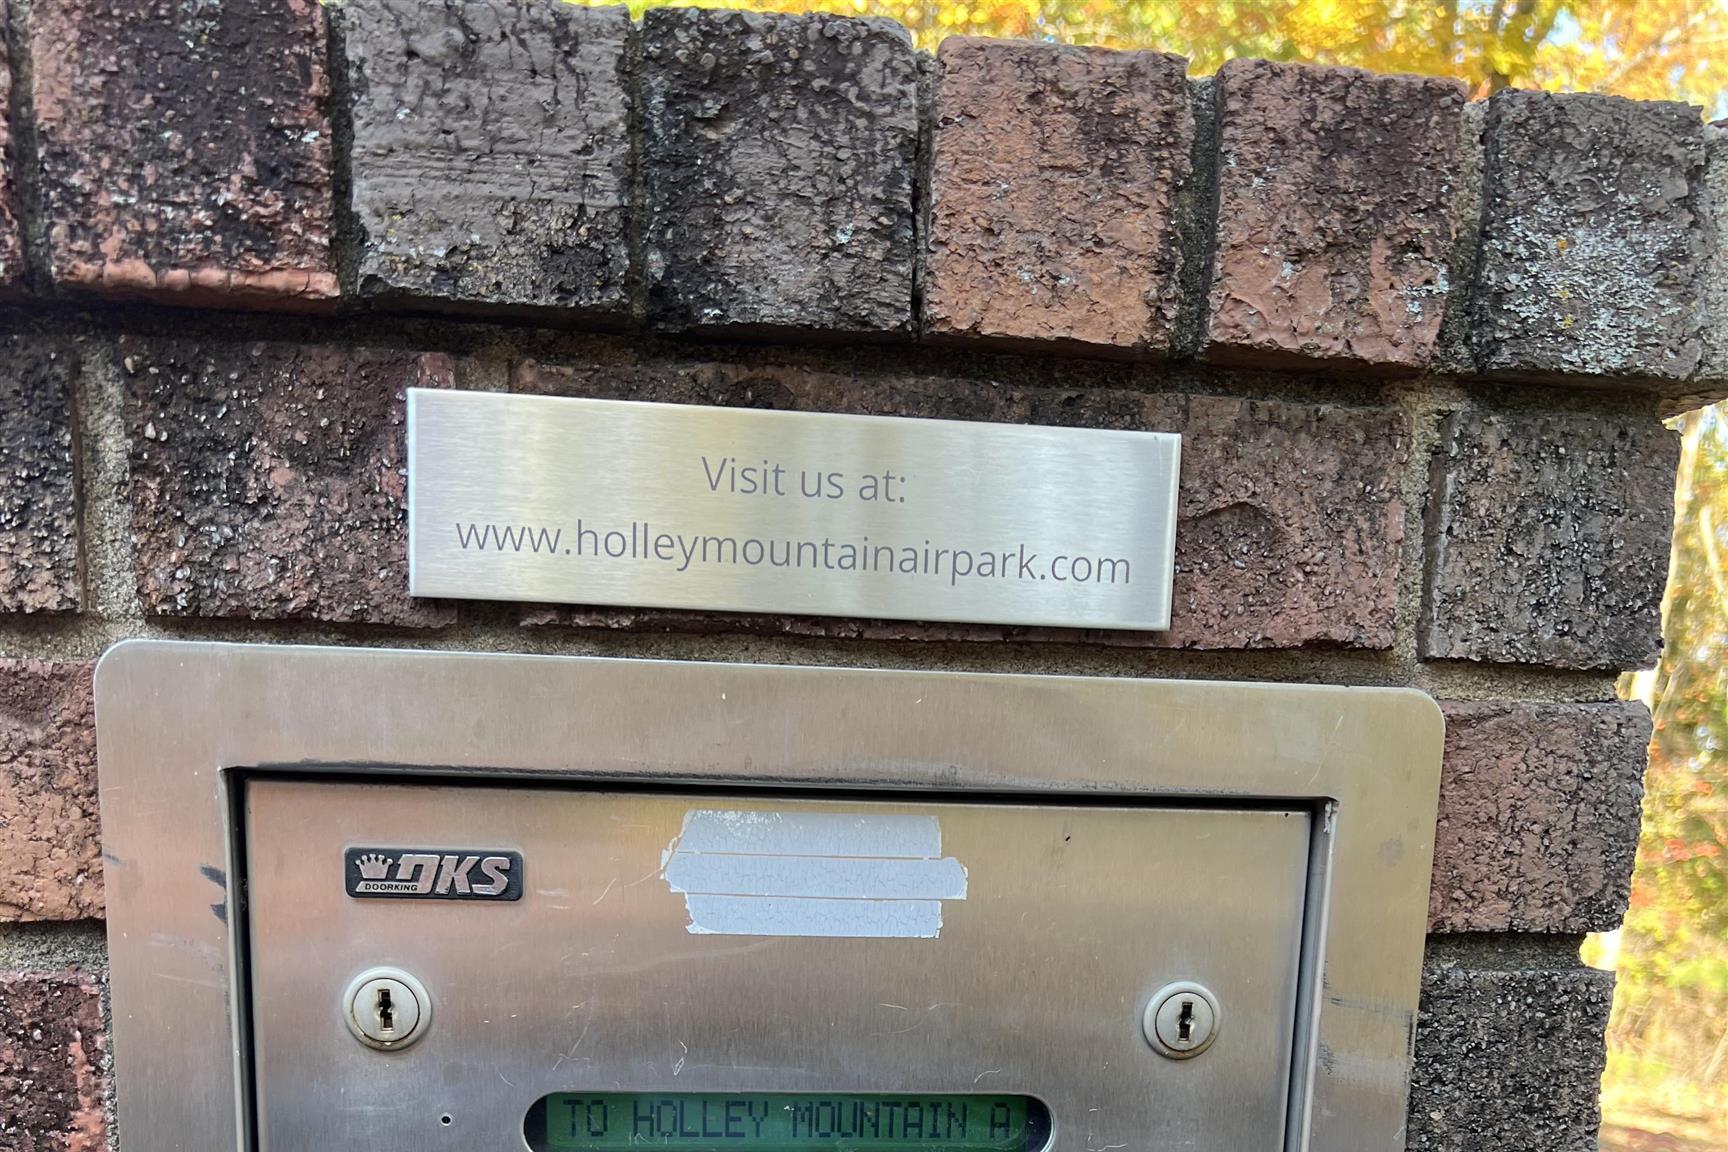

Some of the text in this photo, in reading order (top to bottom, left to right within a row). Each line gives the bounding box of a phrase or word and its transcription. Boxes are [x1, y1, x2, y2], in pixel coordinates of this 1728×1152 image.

[701, 456, 906, 503] Visit us at:
[455, 519, 1132, 586] www.holleymountainairpark.com
[364, 883, 418, 892] DOORKING
[397, 854, 511, 896] DKS
[563, 1099, 1011, 1138] TO HOLLEY MOUNTAIN A
